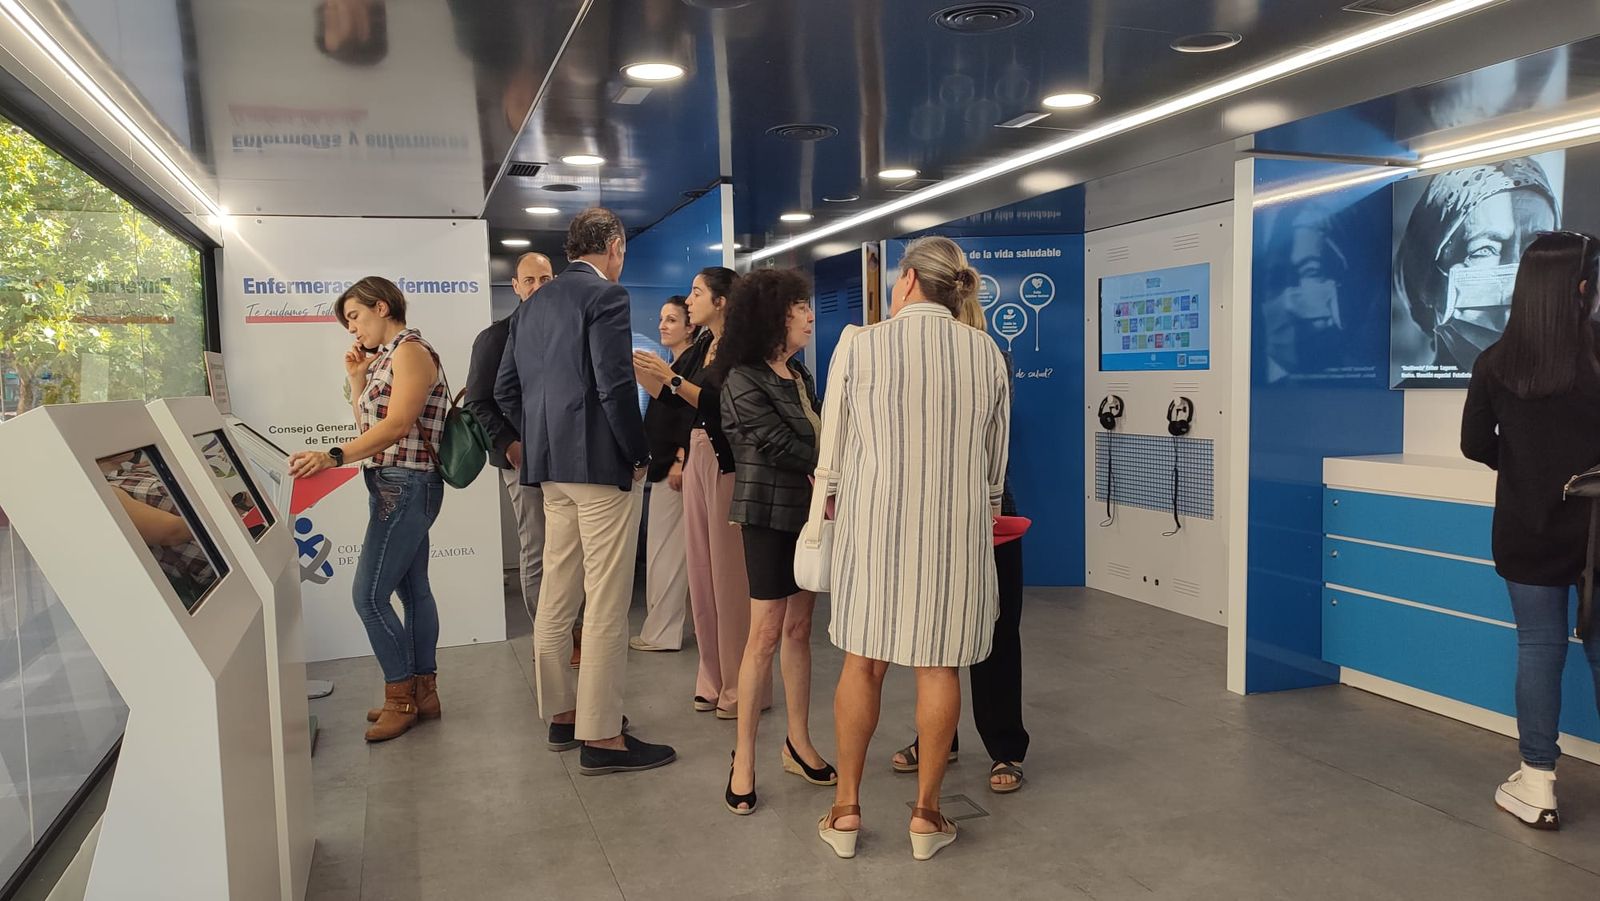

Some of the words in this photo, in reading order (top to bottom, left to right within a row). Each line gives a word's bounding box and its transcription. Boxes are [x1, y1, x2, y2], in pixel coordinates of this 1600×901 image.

[969, 249, 981, 259] de
[983, 249, 992, 259] la
[994, 249, 1014, 259] vida
[1016, 247, 1062, 258] saludable
[395, 277, 479, 294] fermeros
[268, 425, 314, 435] Consejo
[316, 422, 357, 432] General
[305, 436, 319, 445] de
[338, 556, 354, 566] DE
[431, 546, 476, 559] ZAMORA
